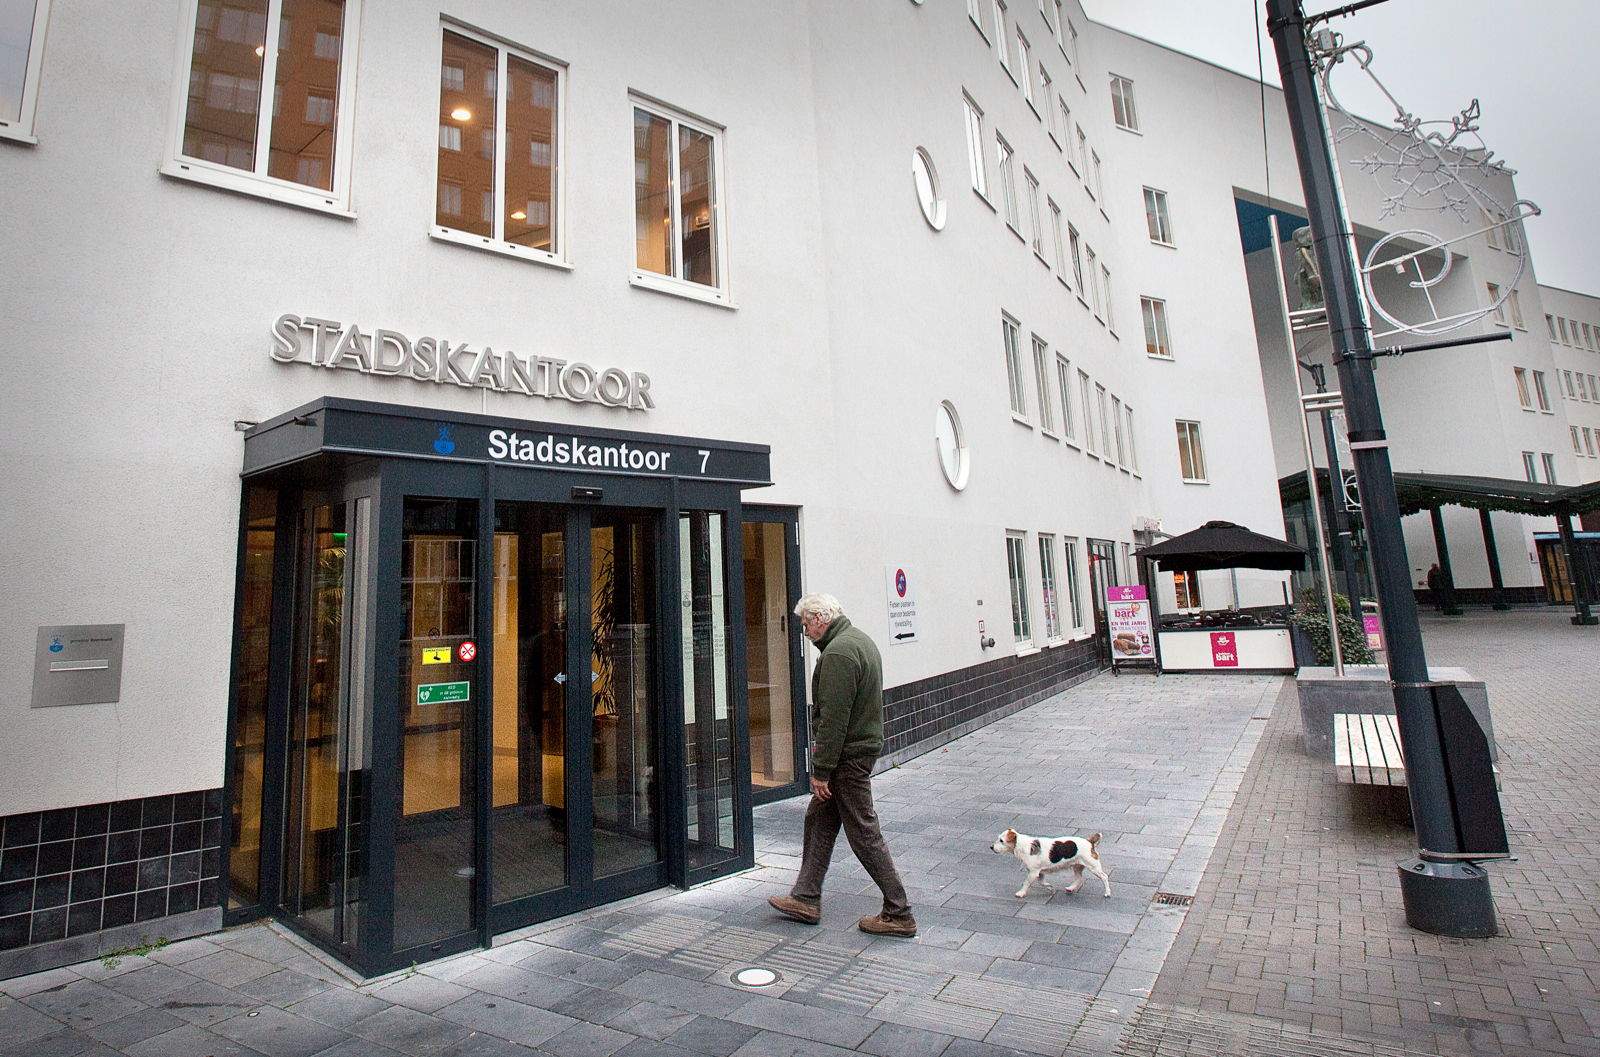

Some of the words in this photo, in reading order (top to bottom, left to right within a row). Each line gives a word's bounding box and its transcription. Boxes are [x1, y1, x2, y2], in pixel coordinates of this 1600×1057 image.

[270, 313, 656, 411] STADSKANTOOR
[487, 430, 671, 471] Stadskantoor
[698, 449, 711, 474] 7
[1114, 609, 1136, 618] bart
[1216, 653, 1234, 661] bart
